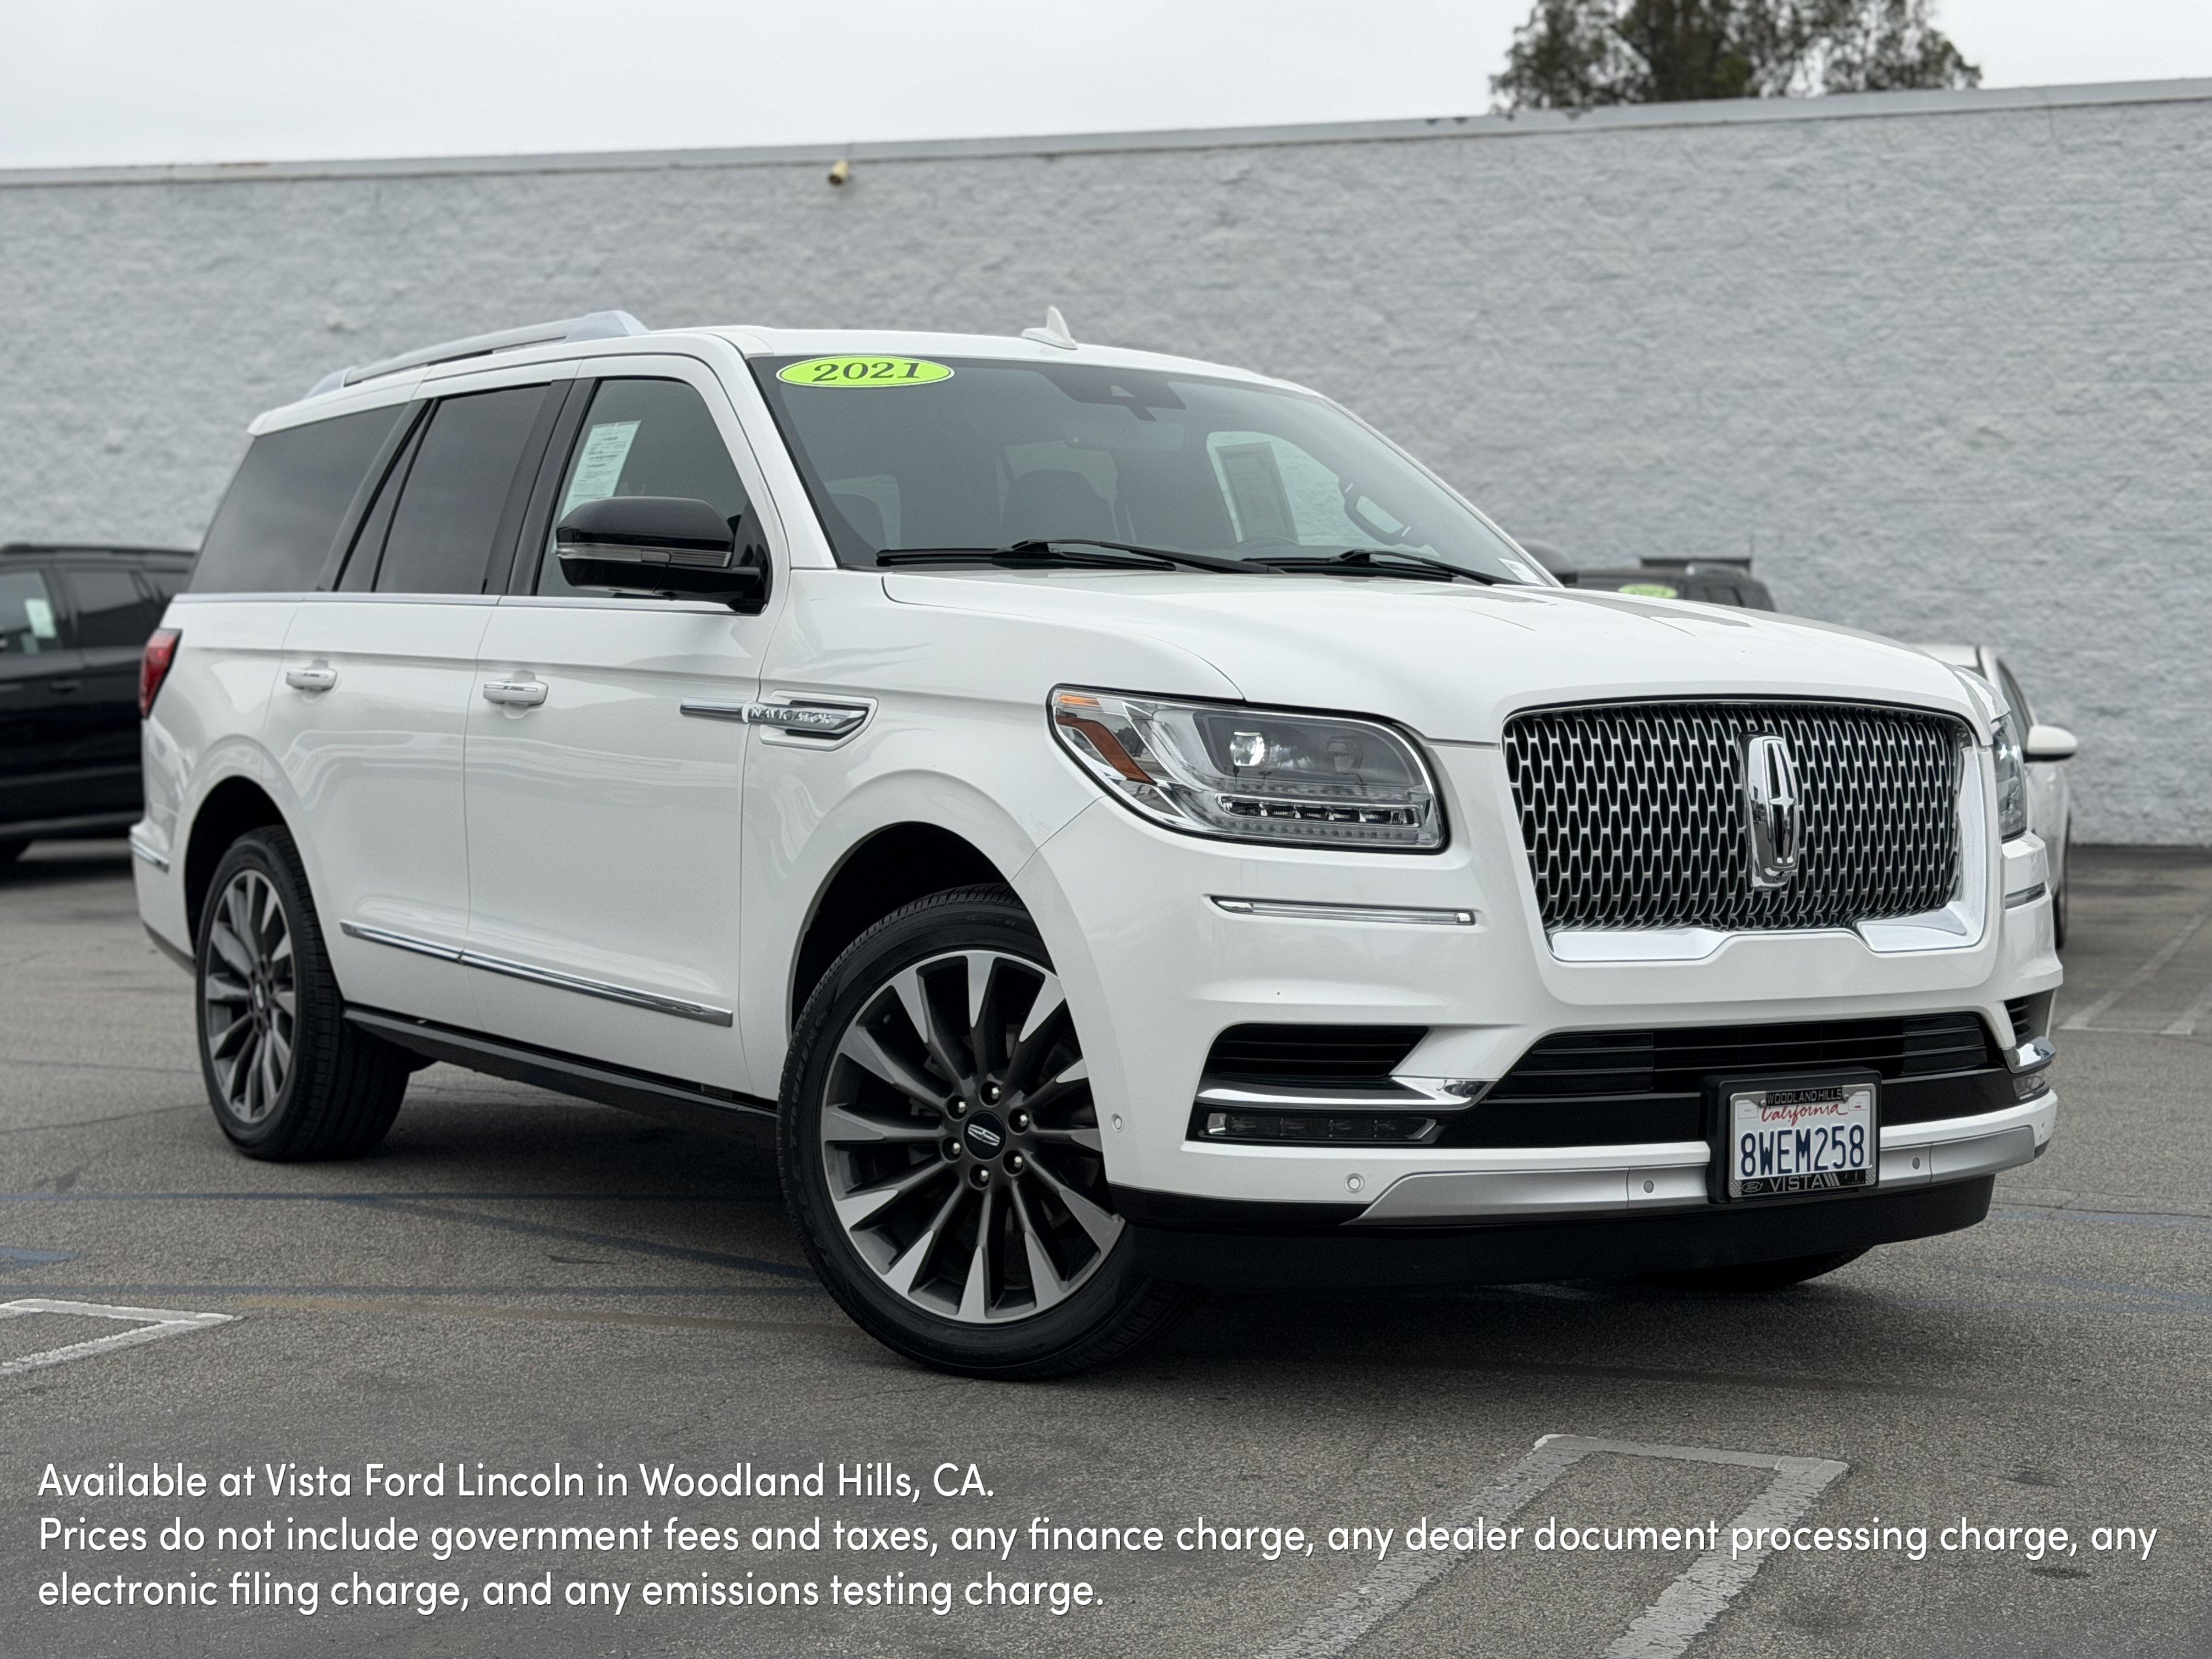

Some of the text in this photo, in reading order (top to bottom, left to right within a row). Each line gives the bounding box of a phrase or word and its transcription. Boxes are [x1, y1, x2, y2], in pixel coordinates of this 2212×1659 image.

[812, 362, 921, 382] 2021
[750, 707, 831, 724] NAVIGATOR
[1767, 1087, 1842, 1105] WOODLAND HILLS
[1762, 1103, 1848, 1126] California
[1741, 1125, 1864, 1177] 8WEM258
[1769, 1173, 1825, 1192] VISTA
